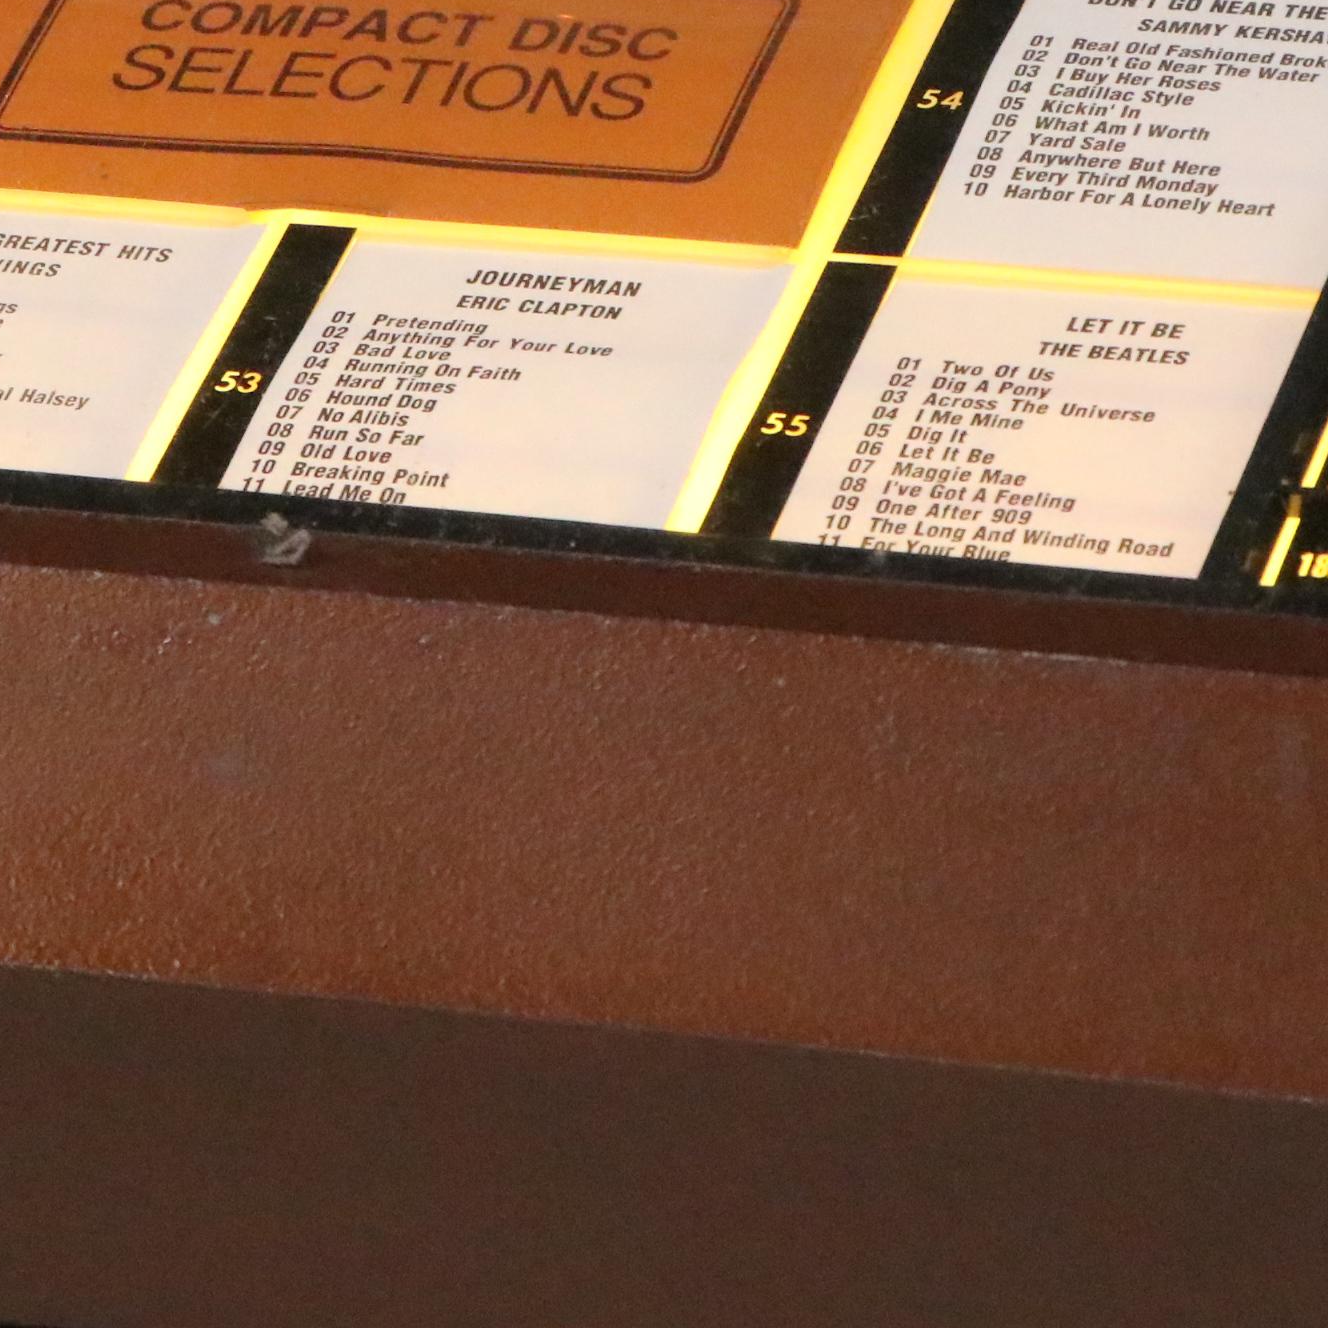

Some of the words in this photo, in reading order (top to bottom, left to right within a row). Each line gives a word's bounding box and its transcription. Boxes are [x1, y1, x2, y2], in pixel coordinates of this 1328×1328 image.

[142, 0, 498, 49] COMPACT
[513, 14, 681, 61] DISC
[1137, 19, 1229, 36] SAMMY
[113, 45, 656, 122] SELECTIONS
[917, 89, 962, 110] 54
[1000, 96, 1026, 110] 05
[1041, 99, 1117, 117] Kickin'
[1120, 105, 1142, 120] In
[117, 242, 173, 263] HITS
[466, 270, 642, 298] JOURNEYMAN
[456, 294, 510, 311] ERIC
[518, 299, 624, 320] CLAPTON
[1067, 317, 1112, 334] LET
[1119, 320, 1146, 336] IT
[1152, 322, 1186, 339] BE
[1038, 341, 1082, 359] THE
[1087, 345, 1191, 365] BEATLES
[214, 372, 261, 393] 53
[760, 413, 810, 436] 55
[252, 459, 274, 475] 10
[291, 461, 387, 485] Breaking
[392, 470, 450, 487] Point
[849, 458, 875, 474] 07
[892, 461, 972, 485] Maggie
[980, 470, 1027, 486] Mae
